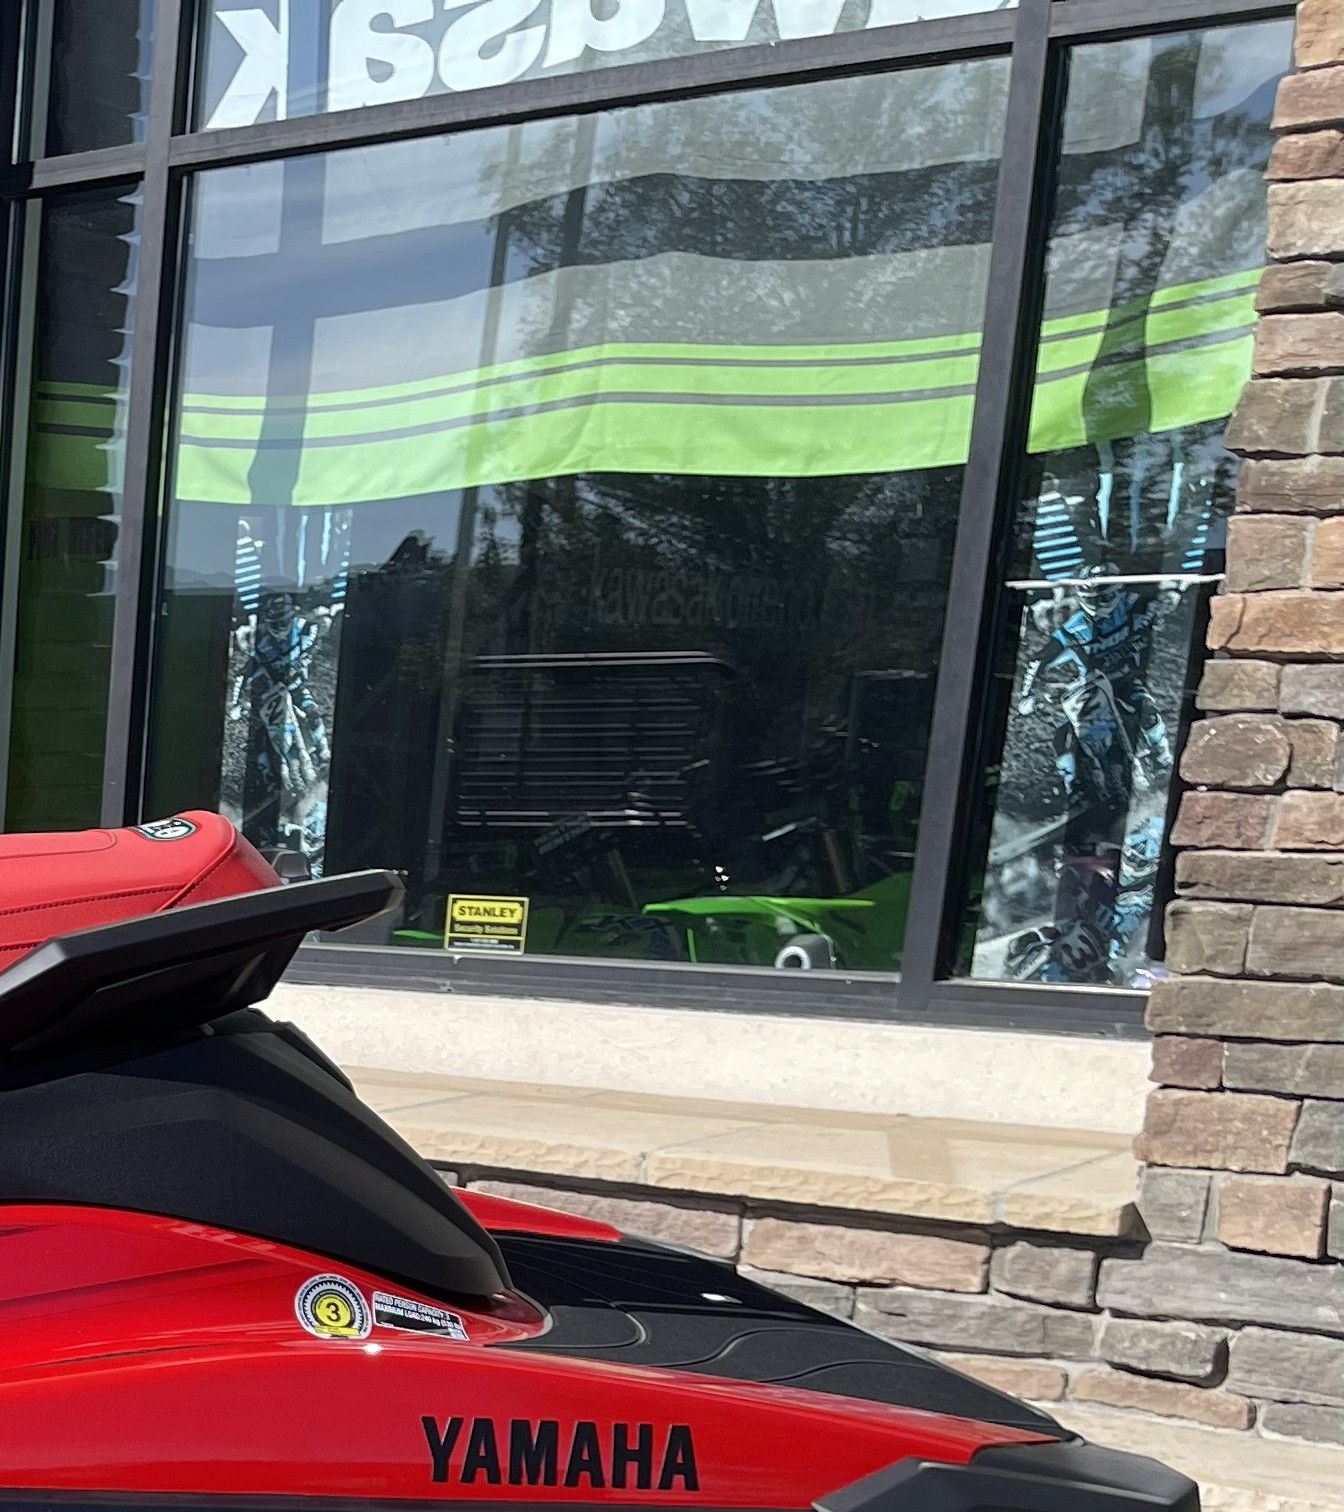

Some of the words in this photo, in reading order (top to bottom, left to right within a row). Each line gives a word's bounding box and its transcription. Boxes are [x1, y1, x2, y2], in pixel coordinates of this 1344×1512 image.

[458, 905, 518, 918] STANLEY
[326, 1302, 341, 1323] 3
[421, 1415, 701, 1491] YAMAHA
